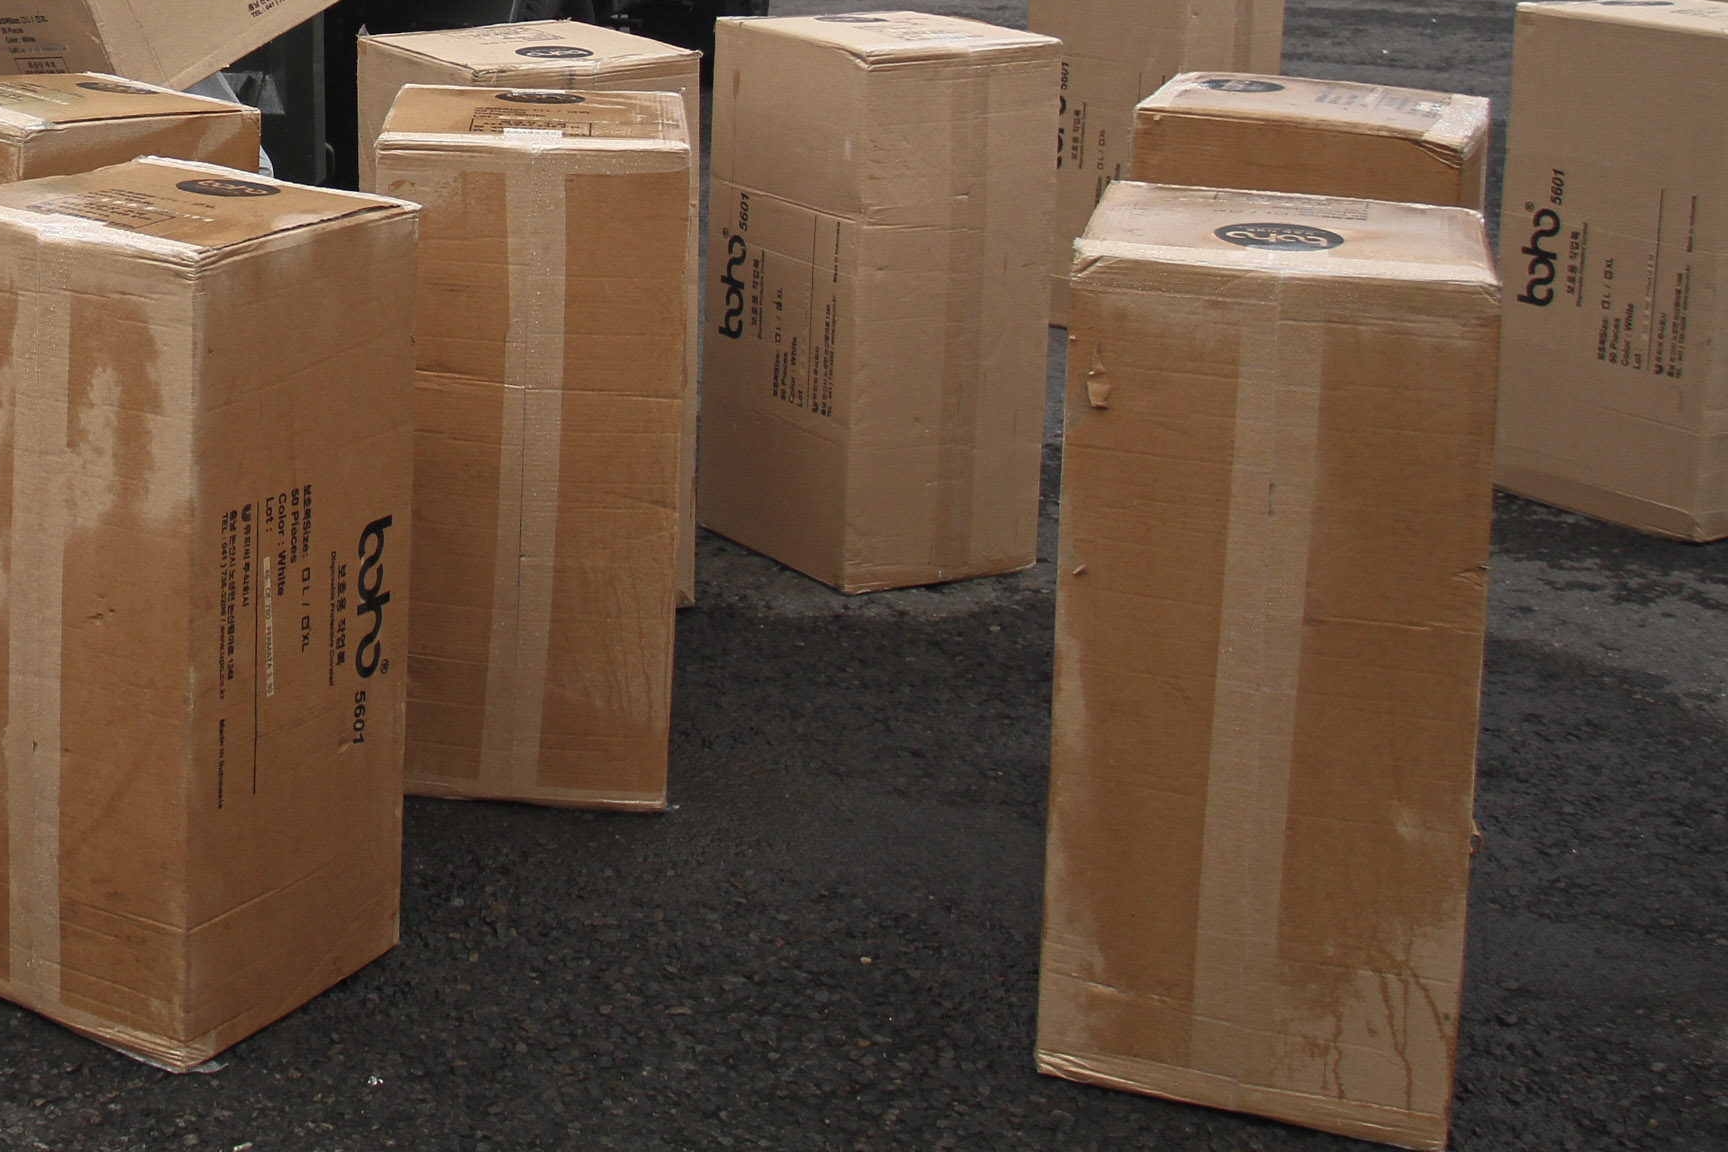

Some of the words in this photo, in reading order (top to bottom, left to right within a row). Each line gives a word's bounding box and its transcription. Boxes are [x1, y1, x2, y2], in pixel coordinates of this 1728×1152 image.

[251, 9, 263, 18] TEL
[1225, 230, 1328, 247] boho
[1517, 208, 1560, 306] boho
[1550, 168, 1564, 206] 5601
[718, 235, 746, 339] boho
[739, 192, 750, 232] 5601
[1611, 317, 1620, 350] Pieces
[1624, 303, 1634, 331] White
[1609, 351, 1617, 364] 50
[1621, 340, 1630, 366] Color
[1633, 353, 1642, 370] Lot
[266, 496, 274, 524] Lot
[278, 493, 287, 536] Color
[291, 488, 299, 506] 50
[290, 510, 299, 564] Pieces
[242, 563, 250, 607] 주식회사
[277, 550, 286, 596] White
[336, 563, 347, 612] 보호용
[355, 514, 393, 679] boho
[301, 631, 310, 653] XL
[336, 617, 346, 666] 작업복
[352, 690, 366, 745] 5601
